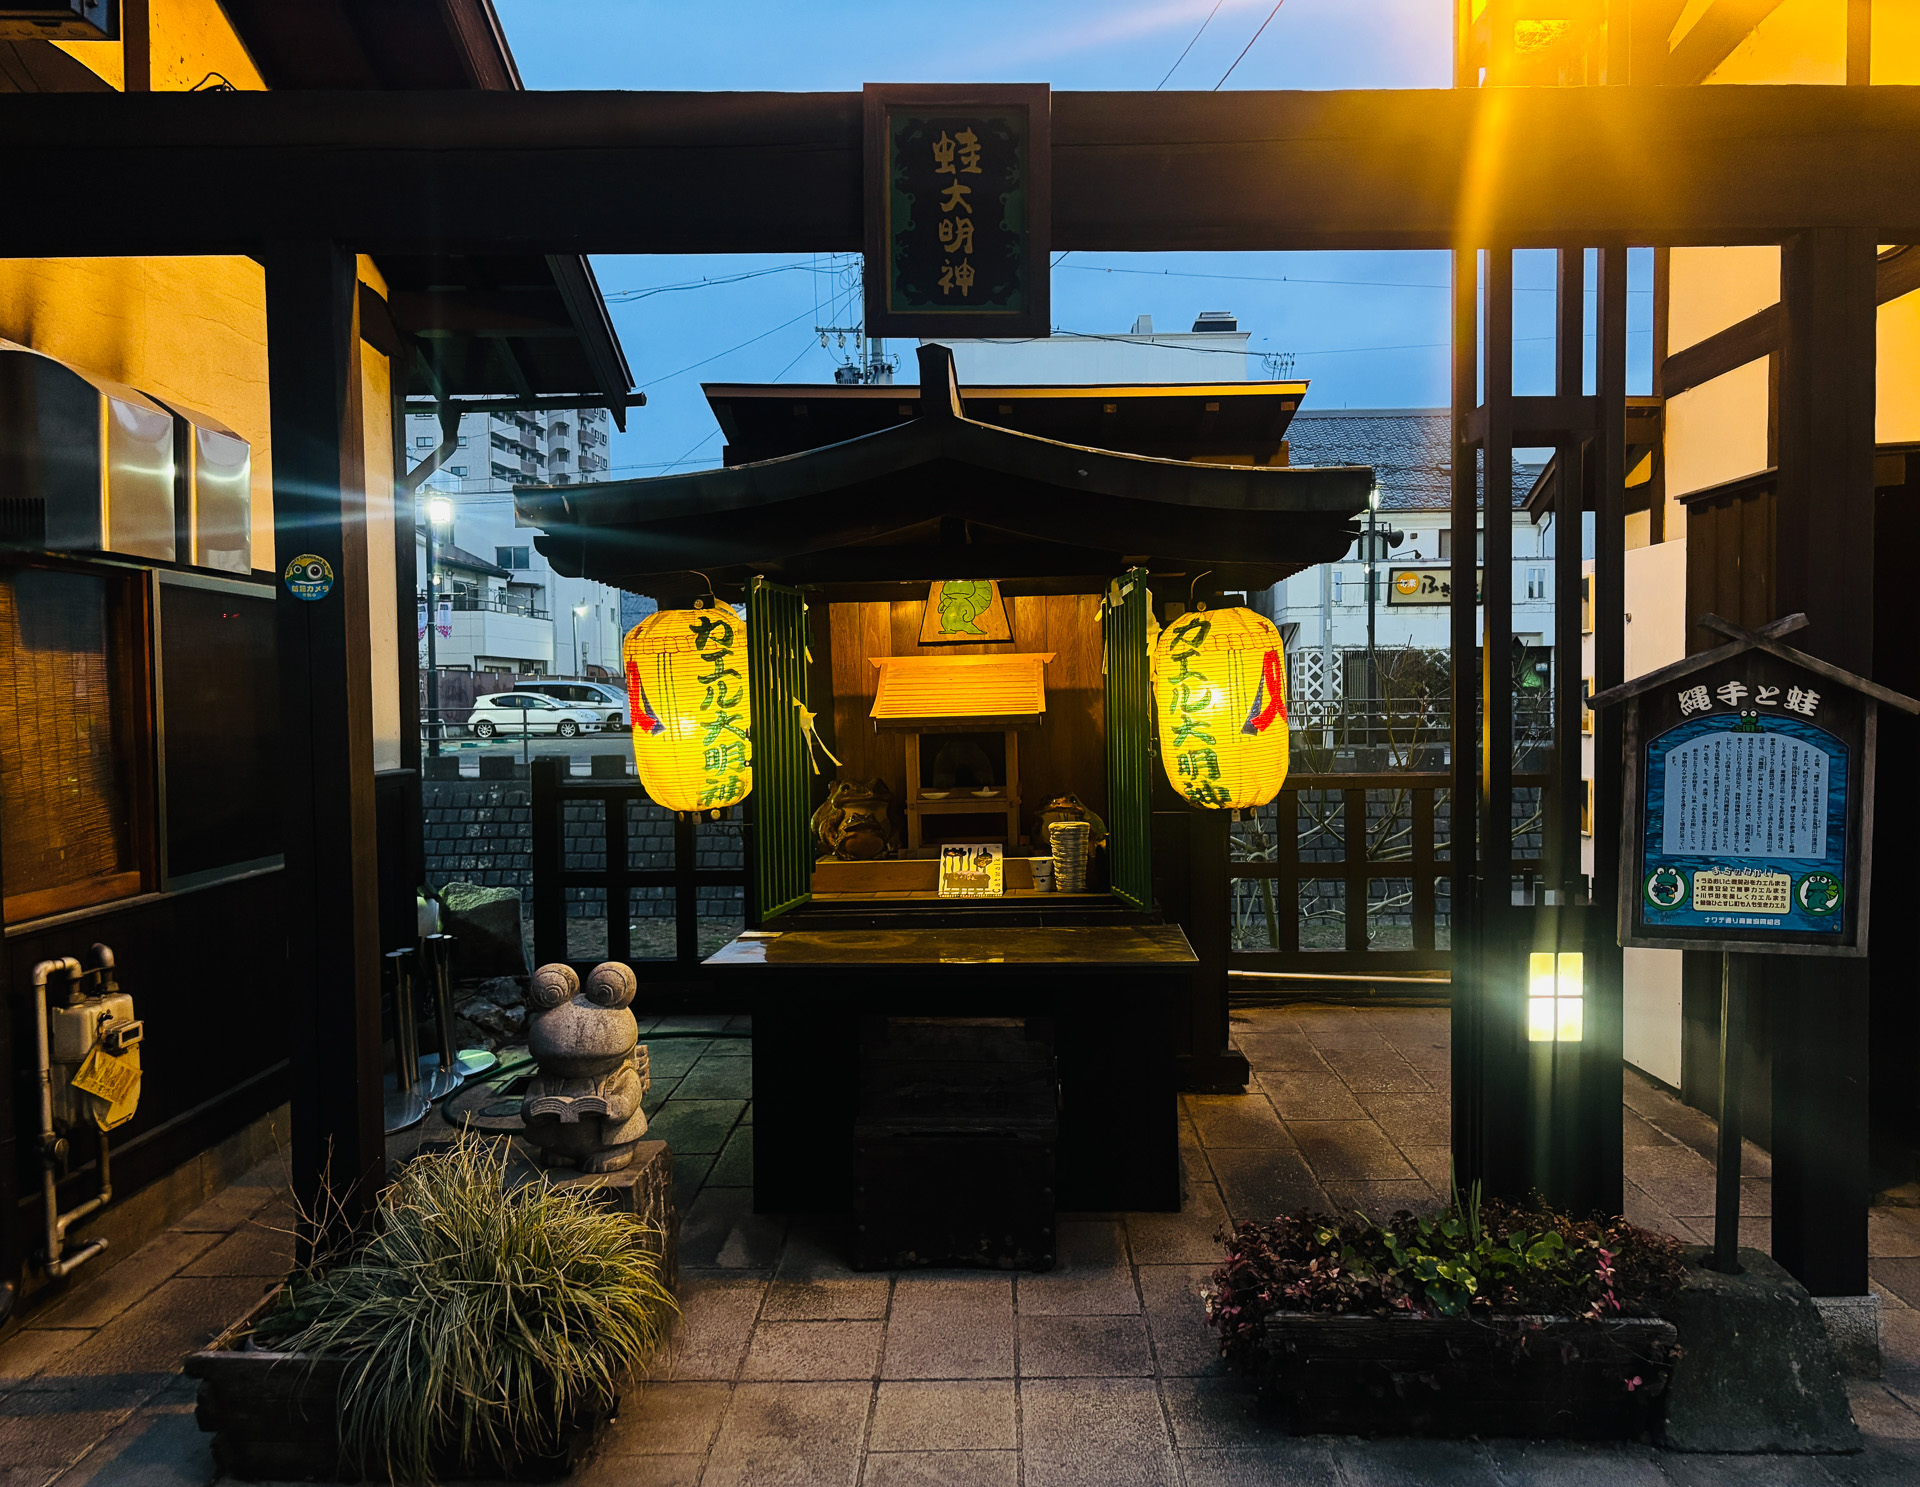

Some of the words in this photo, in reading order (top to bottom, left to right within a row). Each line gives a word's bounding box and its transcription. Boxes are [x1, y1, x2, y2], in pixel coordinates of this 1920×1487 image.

[932, 126, 983, 297] 蛙大明神
[1677, 680, 1821, 717] 縄手と蛙
